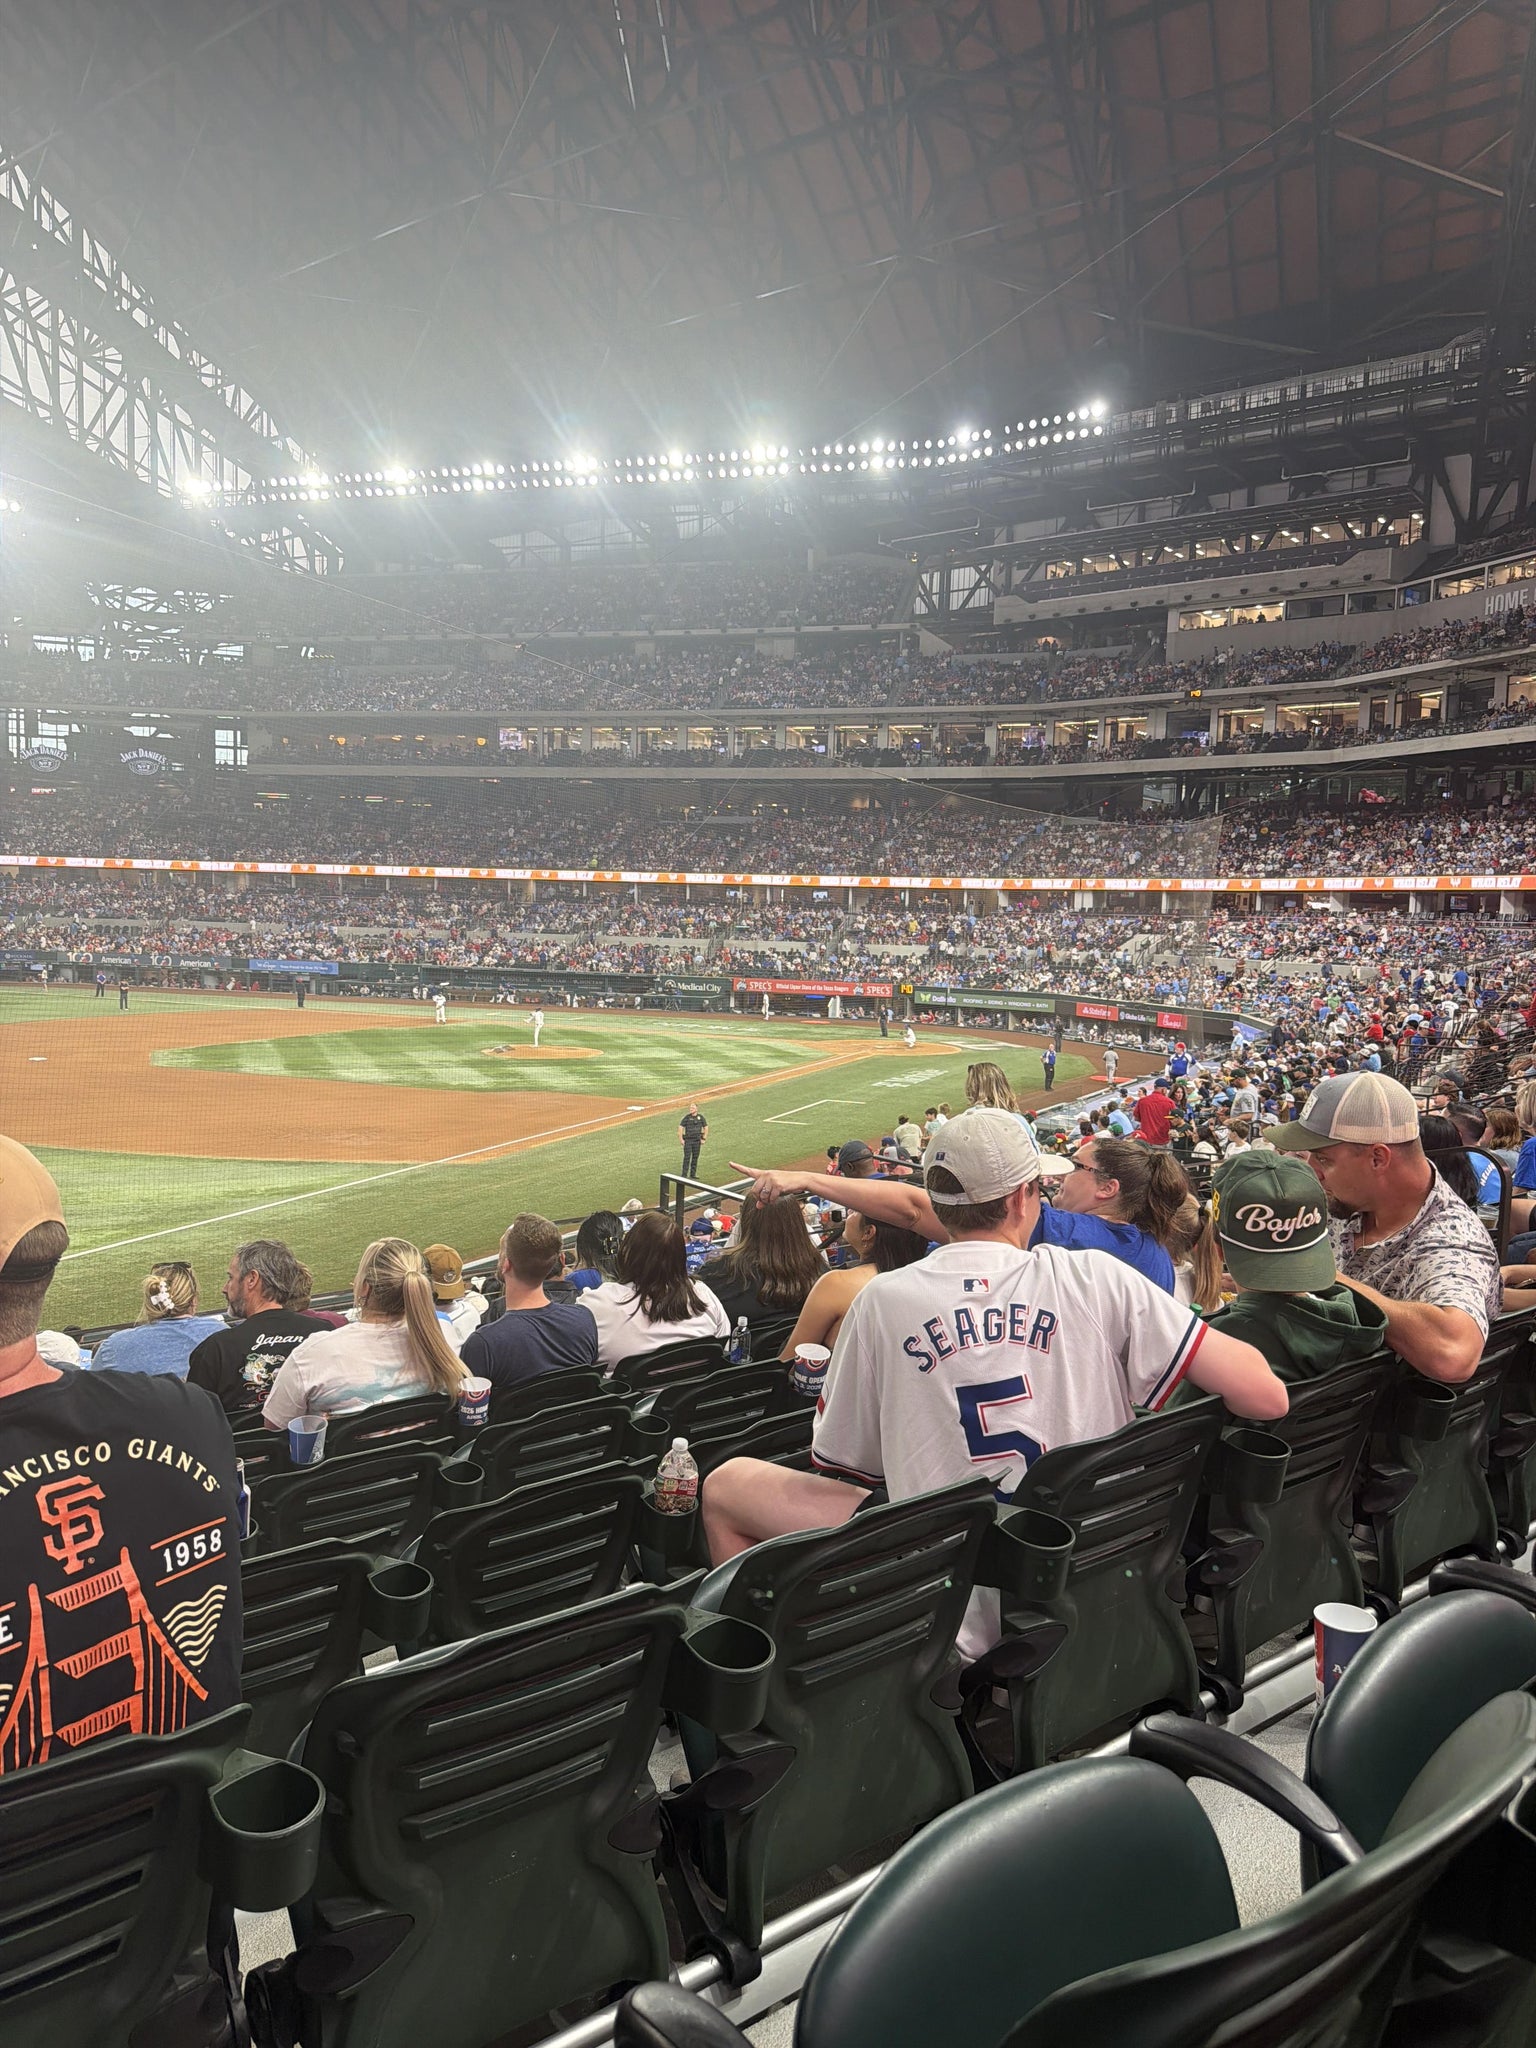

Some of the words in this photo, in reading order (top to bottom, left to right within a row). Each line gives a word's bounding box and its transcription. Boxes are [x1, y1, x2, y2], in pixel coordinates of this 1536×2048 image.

[1485, 588, 1529, 615] HOME
[120, 750, 138, 763] JACK
[101, 956, 132, 964] American
[180, 959, 211, 968] American
[677, 982, 706, 991] Medical
[706, 983, 722, 994] City
[750, 982, 772, 990] SPEC'S
[866, 986, 890, 995] SPEC'S
[1235, 1203, 1322, 1243] Baylor
[251, 1333, 304, 1351] Japan
[903, 1303, 1059, 1375] SEAGER
[955, 1374, 1048, 1500] 5
[127, 1438, 217, 1493] GIANTS
[163, 1528, 223, 1573] 1958
